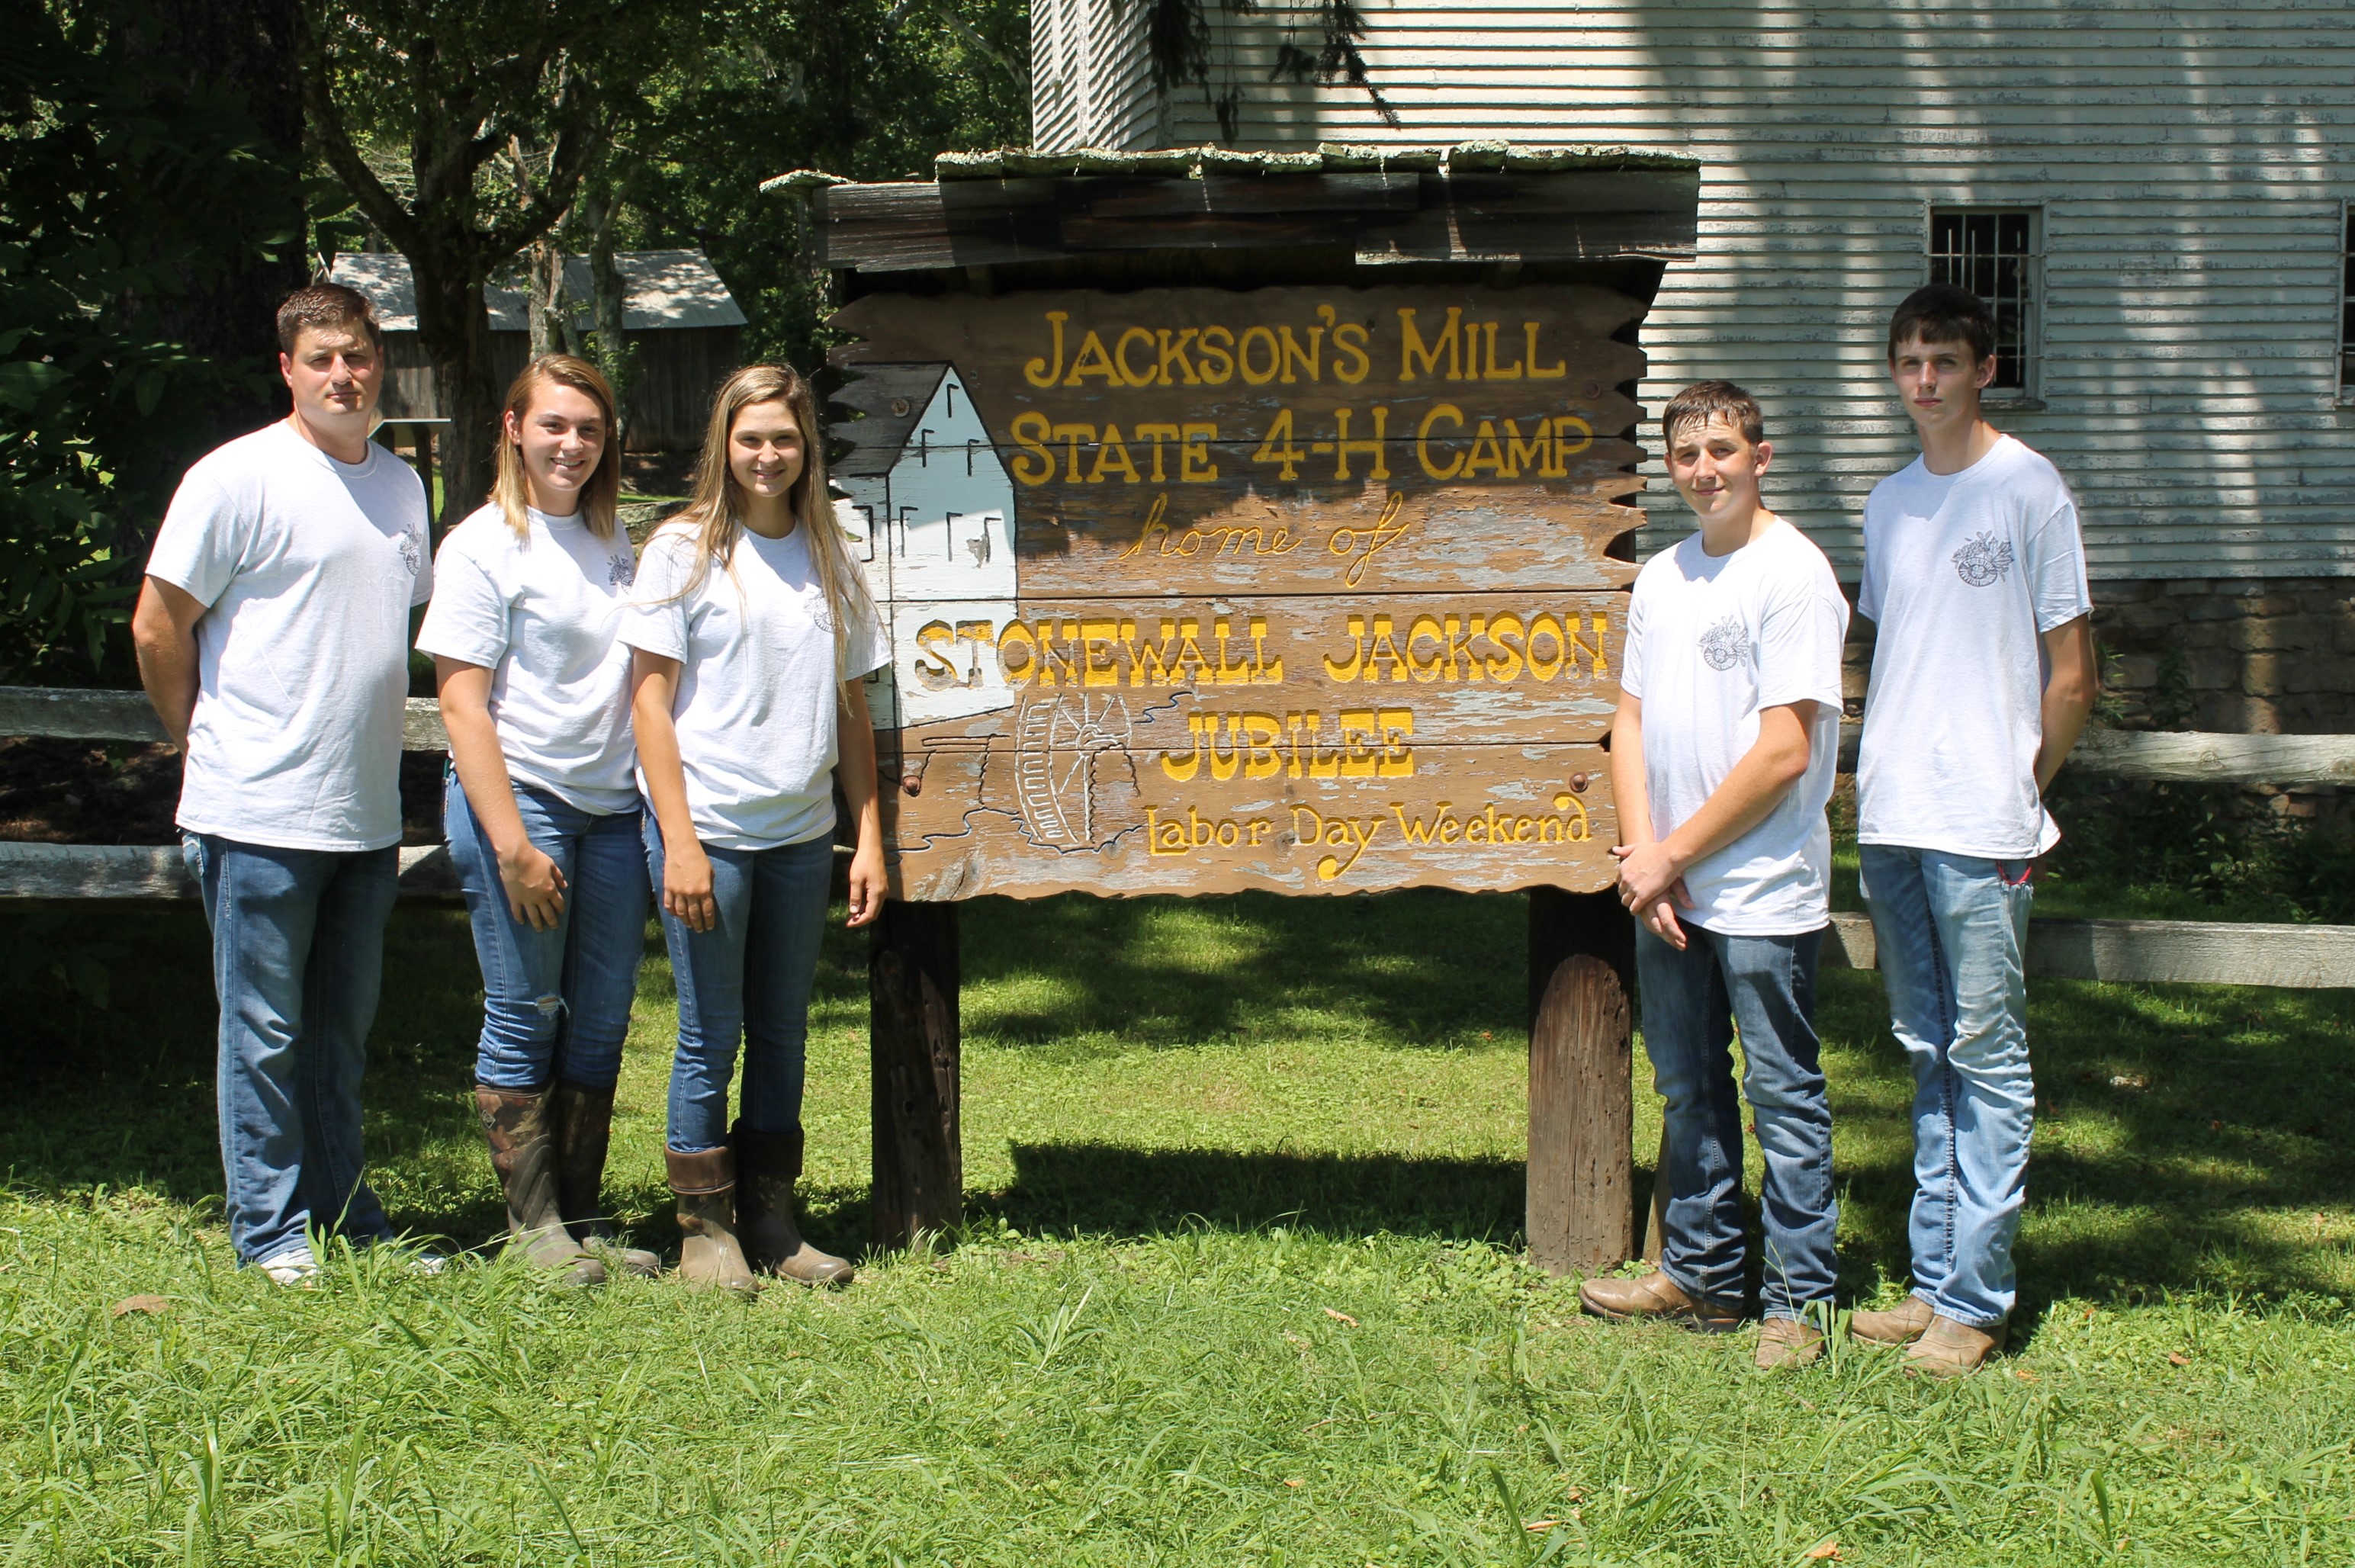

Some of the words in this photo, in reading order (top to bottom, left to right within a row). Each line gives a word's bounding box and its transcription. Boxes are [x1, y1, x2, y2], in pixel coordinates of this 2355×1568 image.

[1023, 304, 1370, 389] JACKSON'S
[1397, 307, 1567, 383] MILL
[1010, 410, 1219, 487] STATE
[1251, 406, 1392, 482] 4-H
[1416, 403, 1593, 480] CAMP
[1119, 492, 1303, 561] home
[1329, 490, 1410, 588] of
[915, 616, 1284, 690] STONEWALL
[1322, 610, 1608, 684] JACKSON
[1159, 706, 1415, 782] JUBILEE
[1145, 804, 1272, 856] Labor
[1289, 803, 1385, 882] Day
[1388, 791, 1592, 847] Weekend
